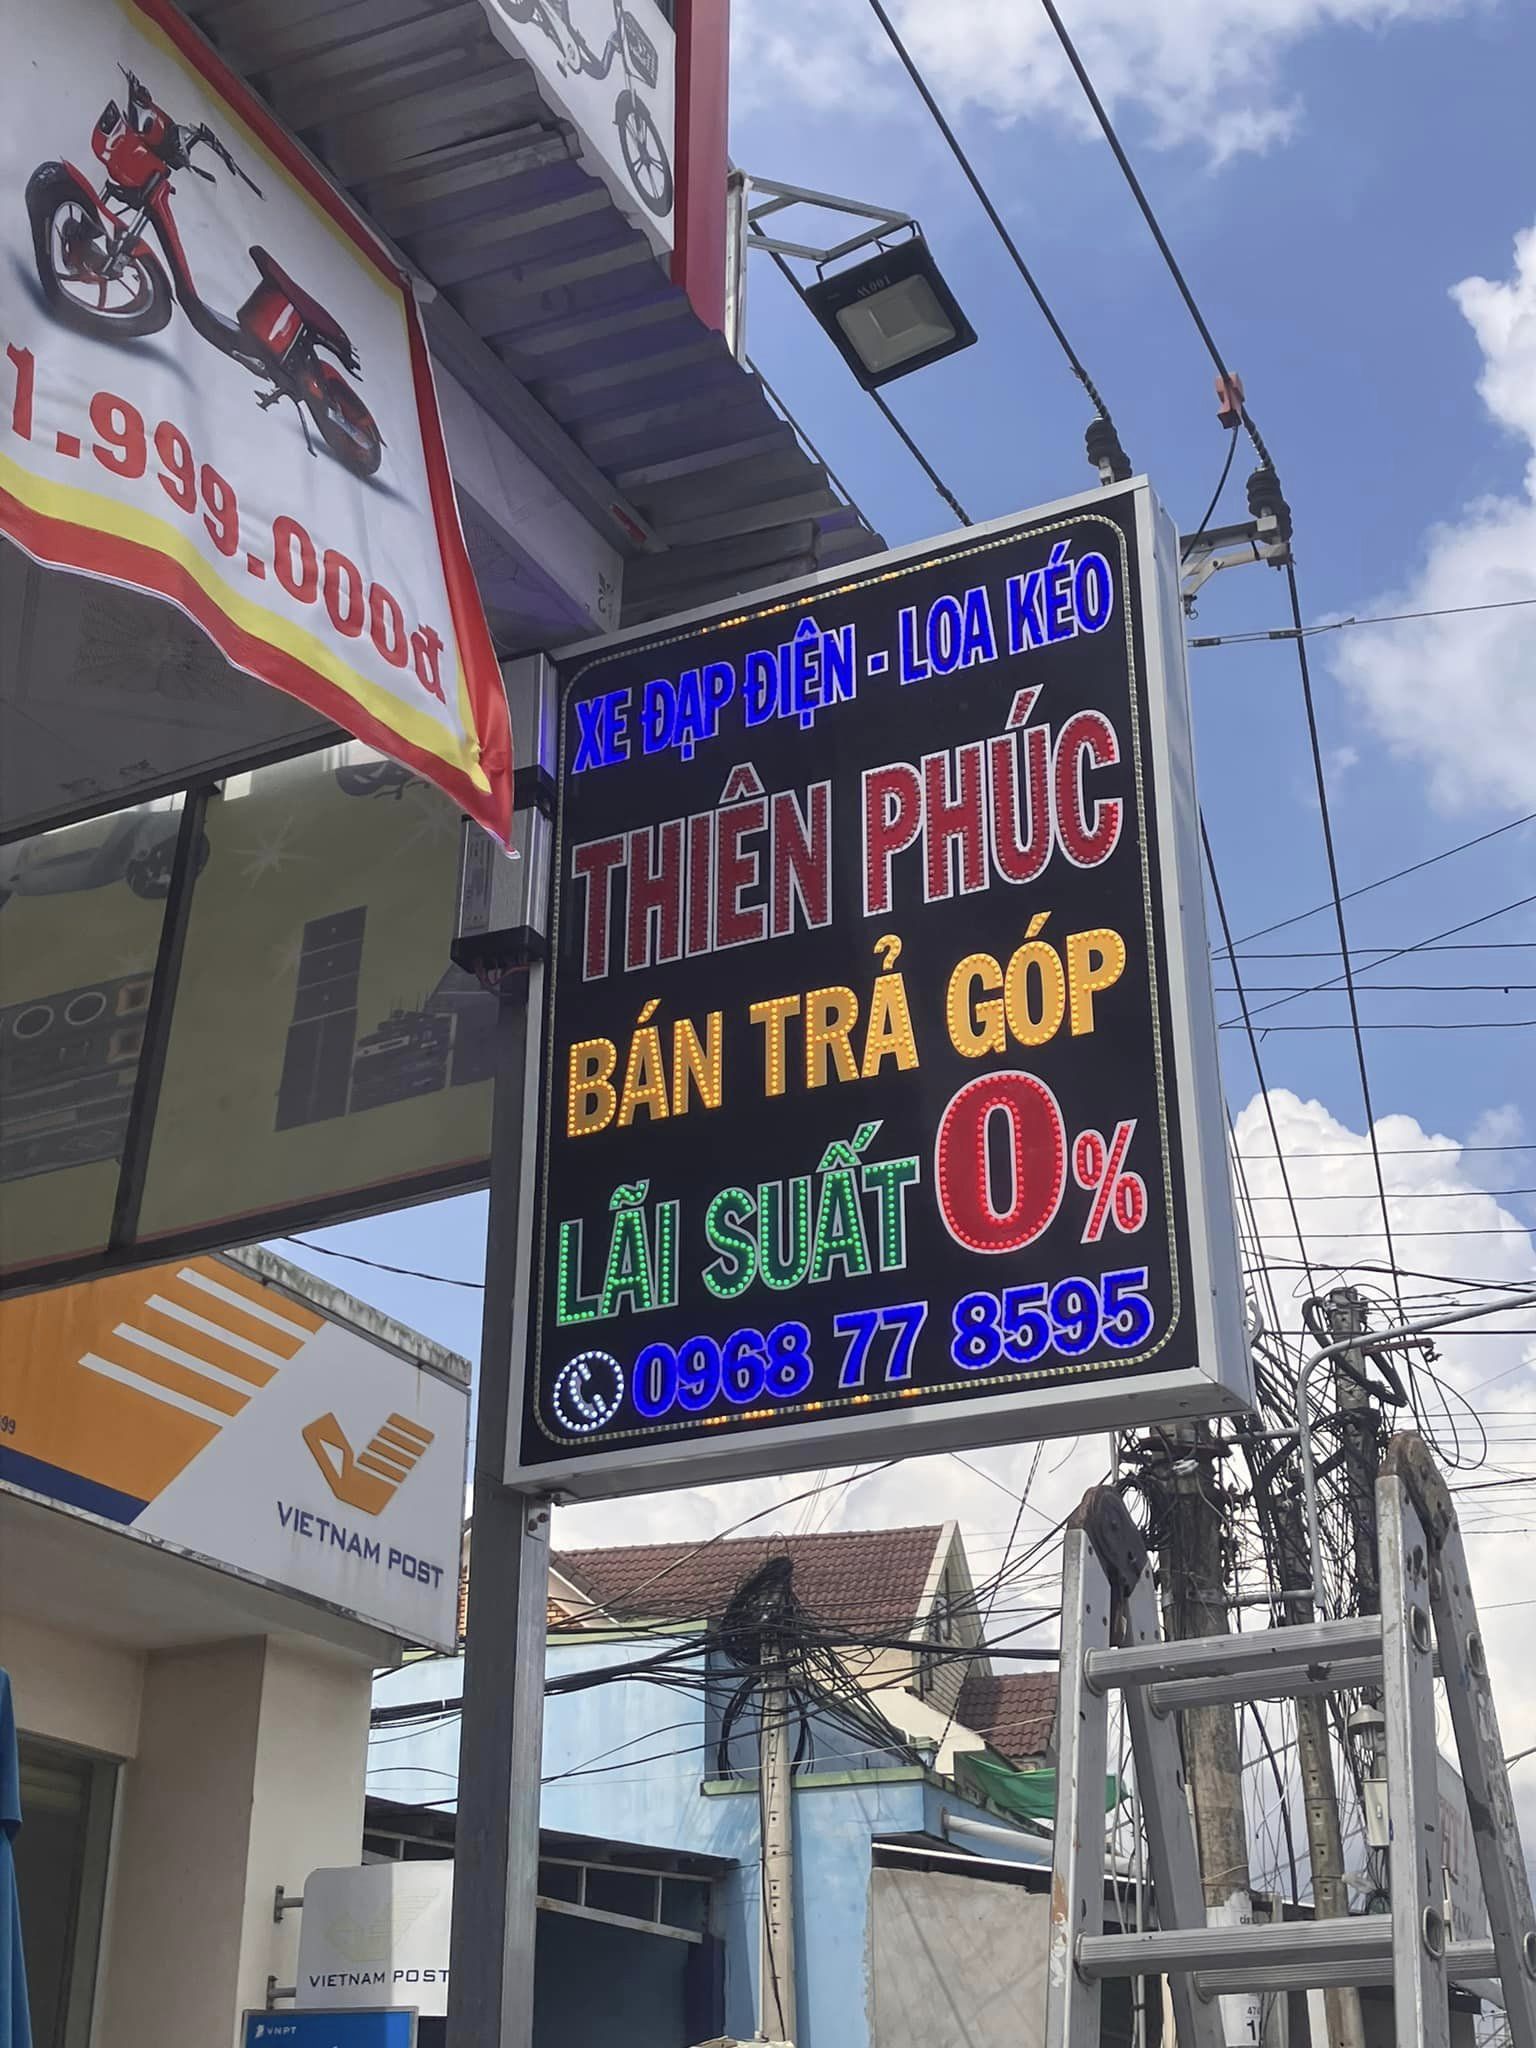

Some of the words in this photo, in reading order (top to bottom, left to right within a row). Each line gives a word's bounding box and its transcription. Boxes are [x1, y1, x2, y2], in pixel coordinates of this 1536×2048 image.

[6, 342, 446, 705] 1.999.000đ
[571, 687, 632, 774] XE
[640, 661, 735, 762] ĐẠP
[742, 615, 857, 730] ĐIỆN
[899, 585, 998, 685] LOA
[1006, 539, 1113, 655] KÉO
[571, 761, 832, 982] THIÊN
[861, 683, 1123, 917] PHÚC
[567, 998, 723, 1137] BÁN
[749, 934, 920, 1097] TRẢ
[946, 911, 1127, 1058] GÓP
[556, 1178, 680, 1326] LÃI
[701, 1120, 920, 1299] SUẤT
[632, 1320, 814, 1417] 0968
[833, 1300, 929, 1388] 77
[951, 1266, 1155, 1370] 8595
[277, 1500, 381, 1565] VIETNAM
[388, 1547, 444, 1589] POST
[267, 2026, 297, 2036] VNPT
[309, 1971, 386, 1988] VIETNAM
[393, 1969, 449, 1983] POST
